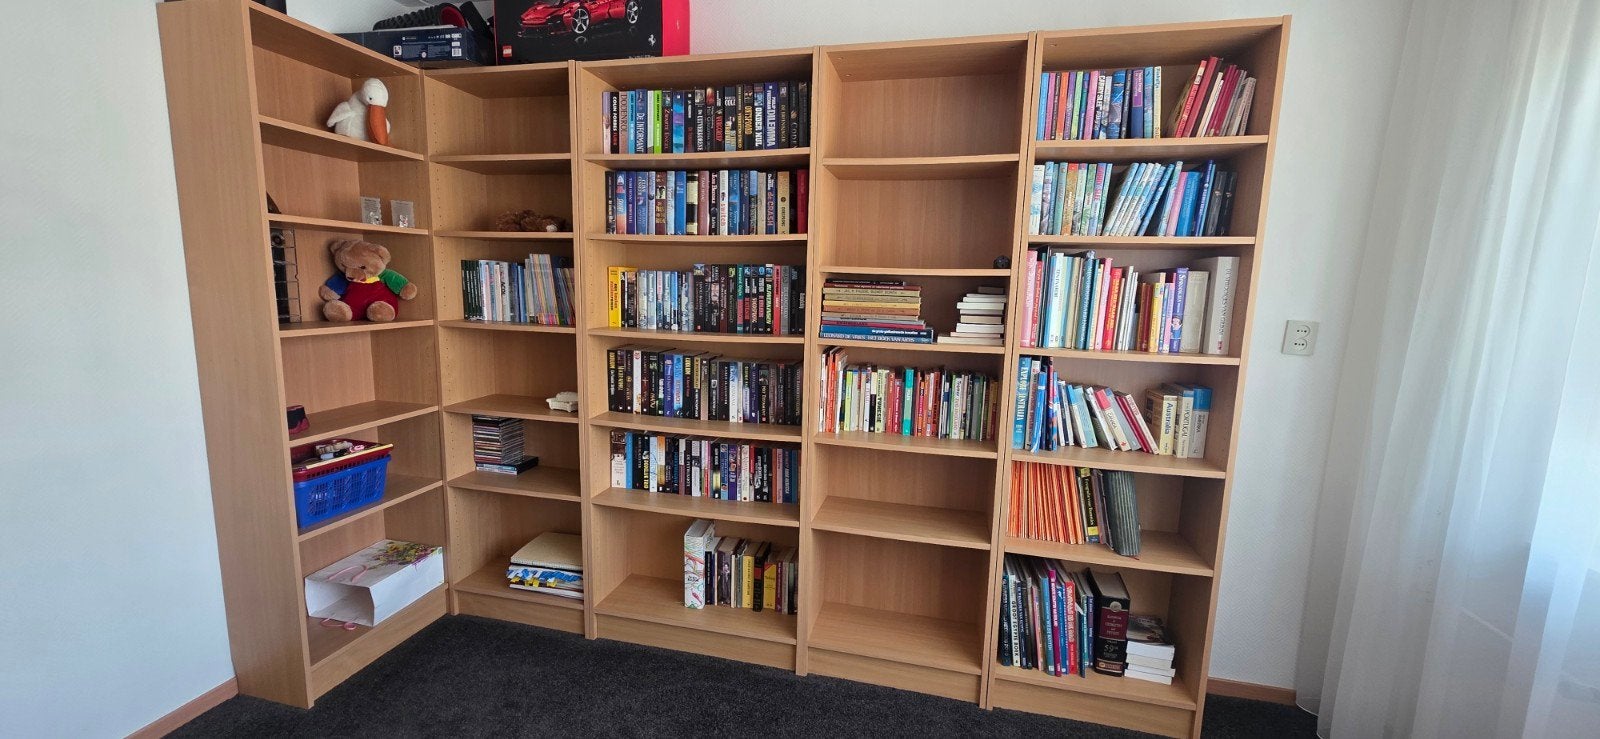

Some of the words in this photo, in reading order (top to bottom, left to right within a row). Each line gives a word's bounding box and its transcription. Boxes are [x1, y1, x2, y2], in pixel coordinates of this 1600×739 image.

[636, 122, 644, 152] INFORMANT
[766, 110, 776, 147] DILEMMA
[1182, 410, 1190, 437] PORTUGAL
